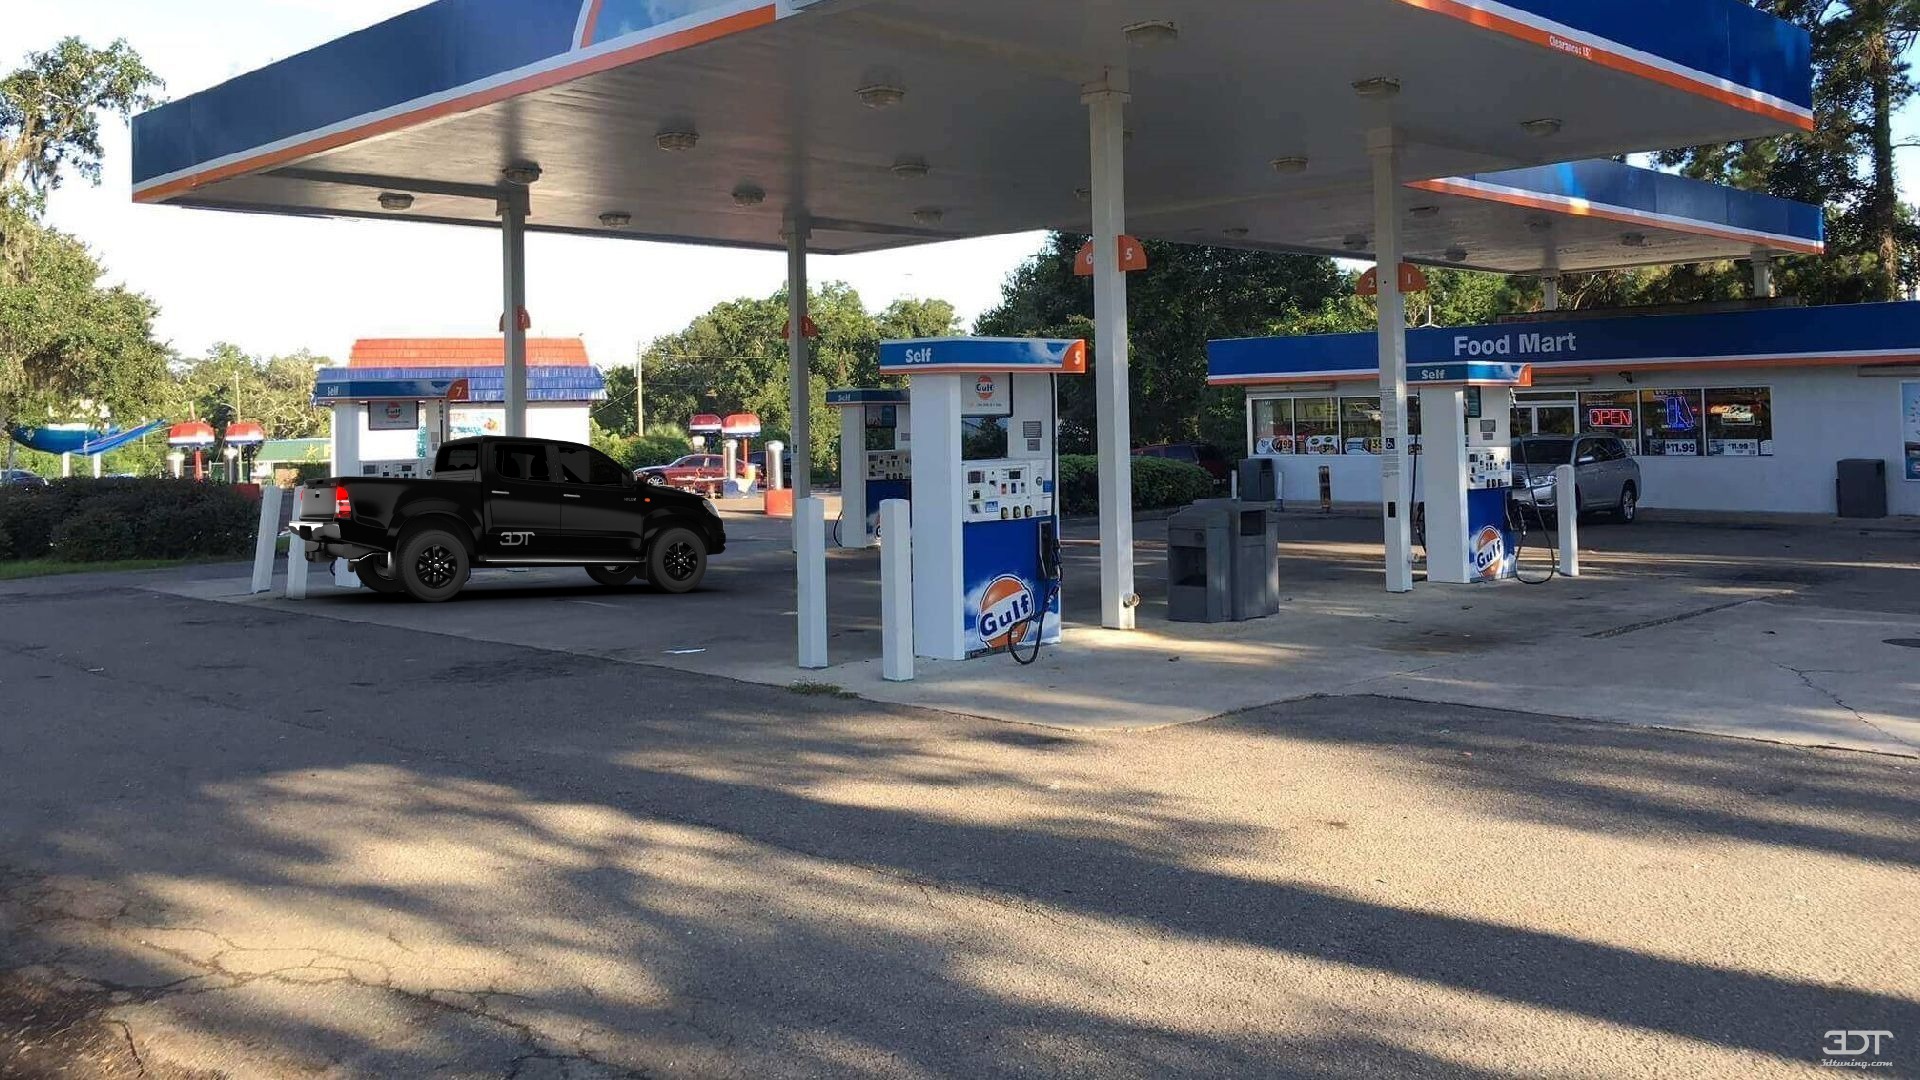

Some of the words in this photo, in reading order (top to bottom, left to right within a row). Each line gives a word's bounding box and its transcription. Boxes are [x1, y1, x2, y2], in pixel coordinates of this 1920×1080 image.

[1125, 248, 1133, 261] 5
[1368, 277, 1375, 288] 2
[1454, 334, 1510, 356] Food
[1518, 332, 1577, 354] Mart
[905, 347, 932, 364] Self
[1074, 351, 1082, 365] 5
[1421, 369, 1446, 380] Self
[456, 386, 463, 397] 7
[976, 382, 994, 393] Gulf
[1591, 410, 1632, 425] OPEN
[1665, 443, 1696, 453] $11.99
[499, 531, 536, 546] 3DT
[1476, 540, 1501, 569] Gulf
[979, 594, 1029, 636] Gulf
